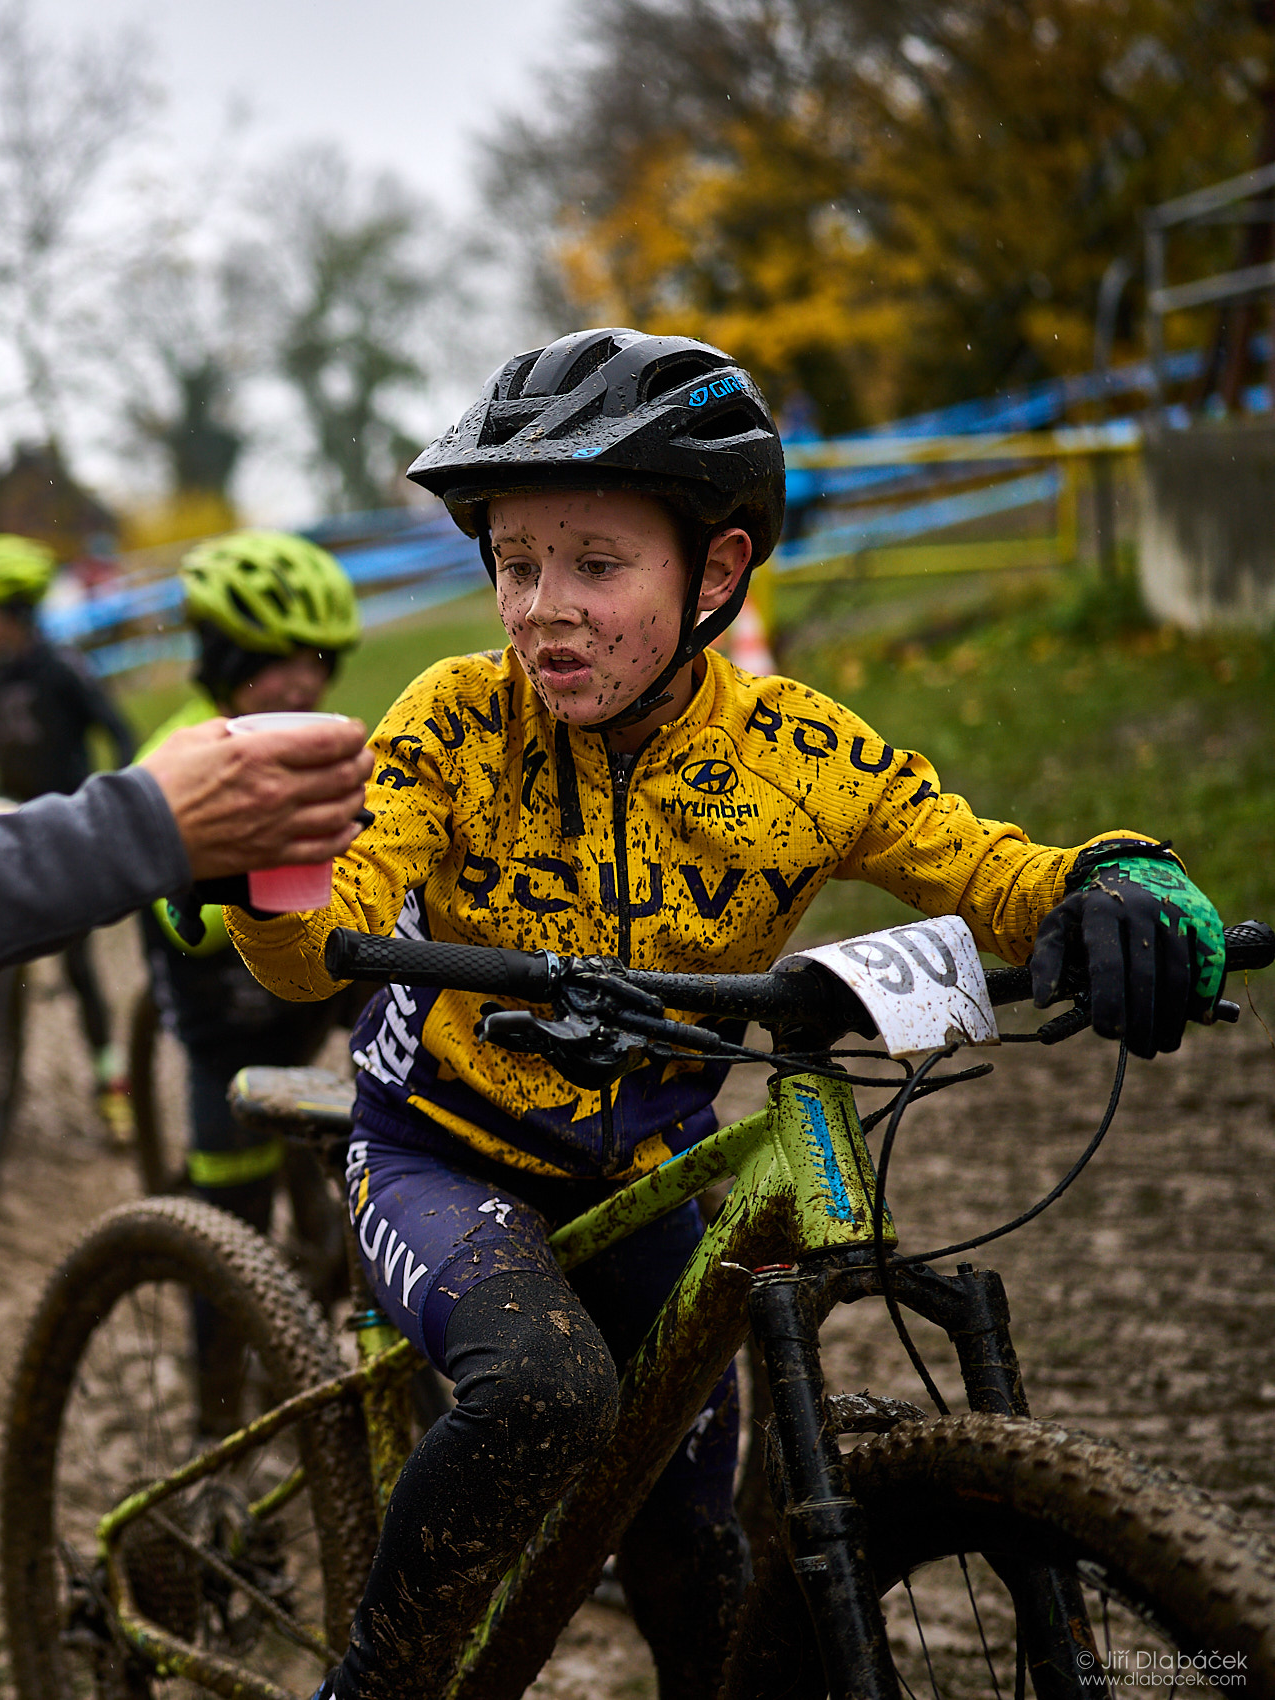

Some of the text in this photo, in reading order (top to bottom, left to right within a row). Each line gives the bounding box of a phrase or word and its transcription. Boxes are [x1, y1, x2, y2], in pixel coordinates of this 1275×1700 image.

[660, 797, 760, 819] HYUNDAI
[456, 850, 820, 920] ROUVY
[839, 926, 958, 995] 90
